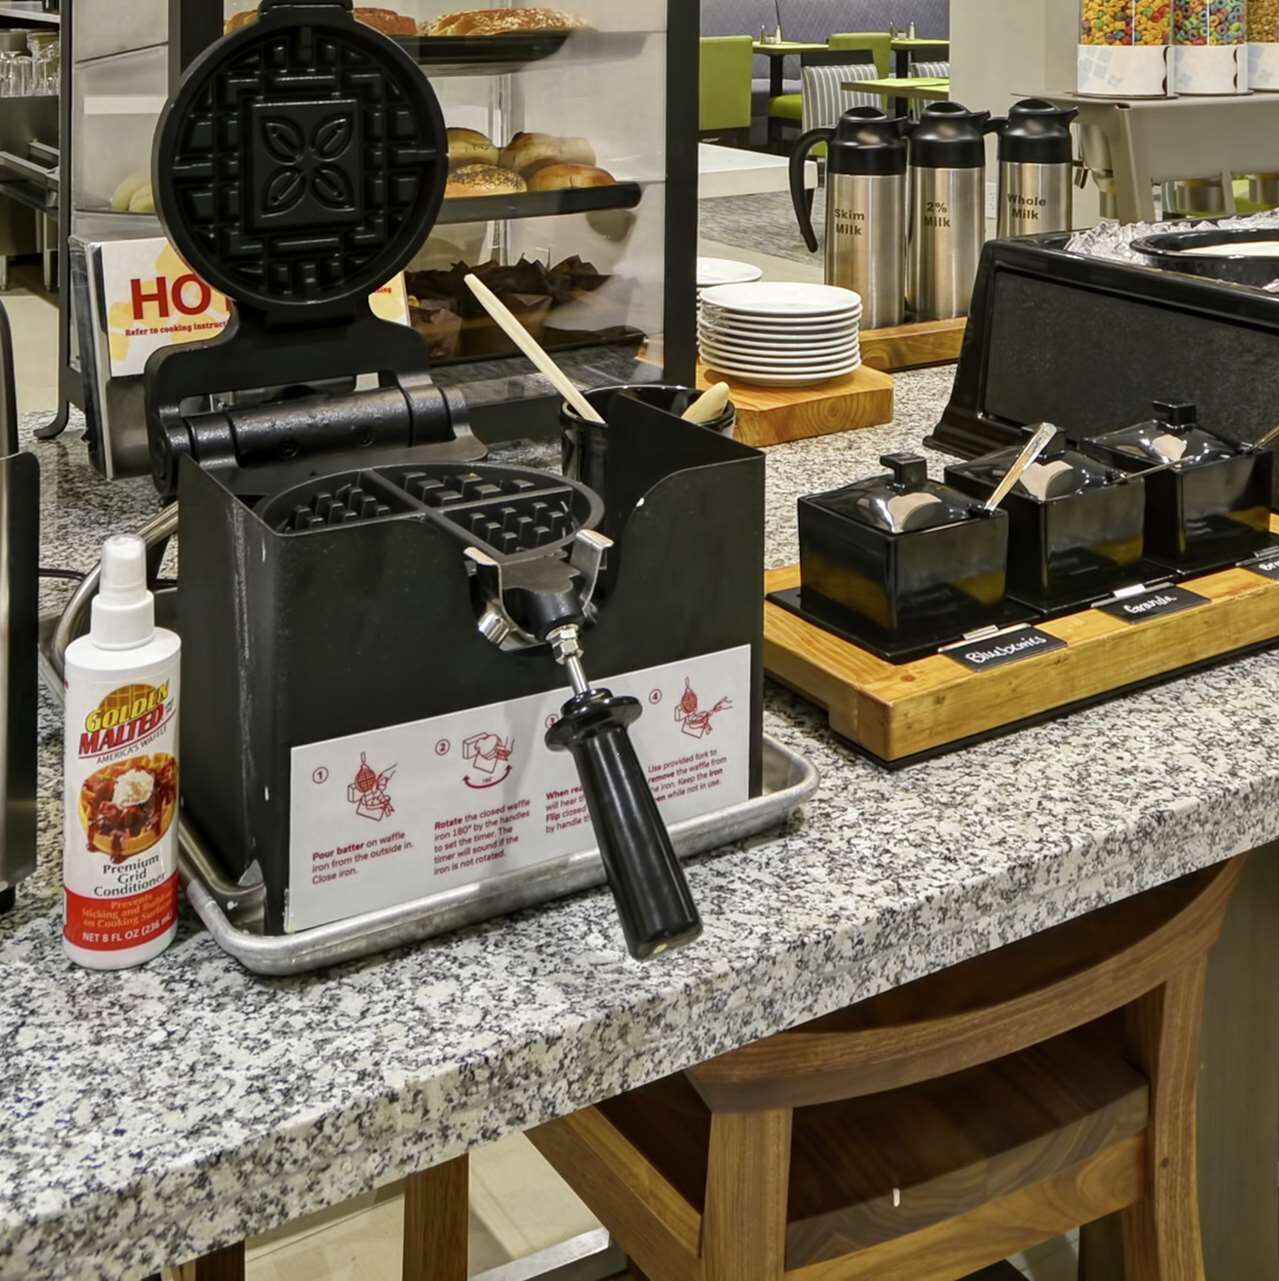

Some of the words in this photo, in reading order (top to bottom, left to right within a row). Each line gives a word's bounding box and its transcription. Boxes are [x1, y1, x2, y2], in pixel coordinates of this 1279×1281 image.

[926, 202, 948, 214] 2%
[1007, 194, 1047, 207] Whole
[834, 208, 865, 221] Skim
[924, 216, 951, 228] Milk
[1012, 208, 1040, 221] Milk
[835, 223, 862, 236] Milk
[124, 328, 148, 337] Refer
[150, 327, 159, 335] to
[160, 324, 193, 333] cooking
[85, 678, 169, 733] GOLDEN
[78, 703, 165, 756] MALTED
[647, 764, 662, 773] Use
[664, 754, 694, 771] provided
[695, 750, 709, 760] fork
[648, 771, 675, 784] remove
[676, 767, 688, 777] the
[689, 761, 711, 773] waffle
[711, 756, 728, 766] from
[696, 771, 708, 780] the
[545, 788, 569, 800] When
[434, 817, 463, 830] Rotate
[464, 812, 478, 822] the
[479, 805, 506, 819] closed
[506, 798, 531, 812] waffle
[562, 804, 588, 818] closed
[434, 830, 451, 842] iron
[473, 822, 483, 834] by
[485, 818, 499, 829] the
[499, 810, 530, 825] handles
[545, 825, 556, 835] by
[556, 817, 583, 831] handle
[312, 849, 335, 861] Pour
[336, 841, 365, 856] batter
[366, 839, 378, 848] on
[379, 831, 406, 845] waffle
[434, 844, 443, 854] to
[444, 840, 457, 850] set
[458, 836, 473, 846] the
[498, 825, 513, 837] The
[312, 861, 330, 874] iron
[331, 856, 353, 869] from
[354, 852, 369, 863] the
[370, 843, 402, 859] outside
[433, 852, 456, 865] timer
[457, 847, 471, 858] will
[472, 840, 498, 855] sound
[505, 834, 519, 846] the
[103, 854, 160, 875] Premium
[433, 864, 450, 876] iron
[451, 861, 459, 870] is
[459, 857, 474, 869] not
[93, 872, 166, 898] Conditioner
[117, 868, 147, 885] Grid
[312, 874, 337, 885] Close
[82, 931, 100, 943] NET
[101, 932, 110, 943] 8
[111, 931, 122, 941] FL
[124, 928, 140, 940] OZ
